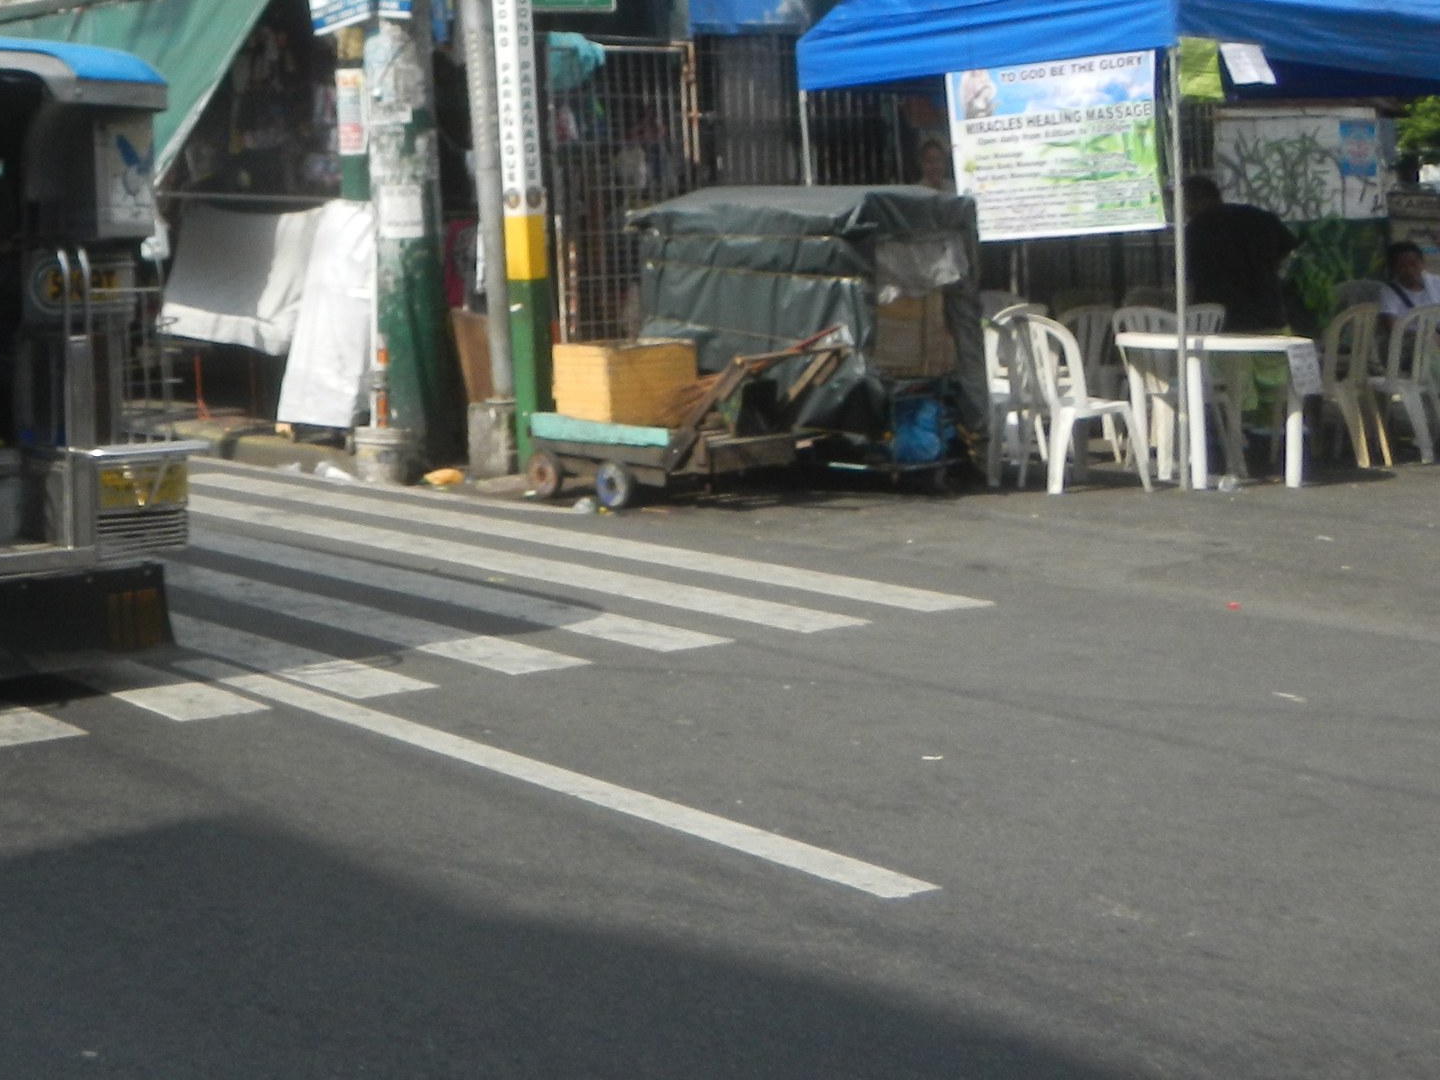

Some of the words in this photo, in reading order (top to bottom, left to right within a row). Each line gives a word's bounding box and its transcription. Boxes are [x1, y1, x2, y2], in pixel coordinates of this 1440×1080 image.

[1001, 71, 1016, 83] TO
[1021, 68, 1046, 82] GOD
[1050, 66, 1065, 77] BE
[1070, 62, 1095, 75] THE
[1099, 54, 1143, 71] GLORY
[966, 116, 1024, 136] MIRACLES
[1026, 109, 1082, 129] HEALING
[1086, 103, 1153, 122] MASSAGE
[978, 135, 998, 147] Open
[1001, 131, 1020, 144] daily
